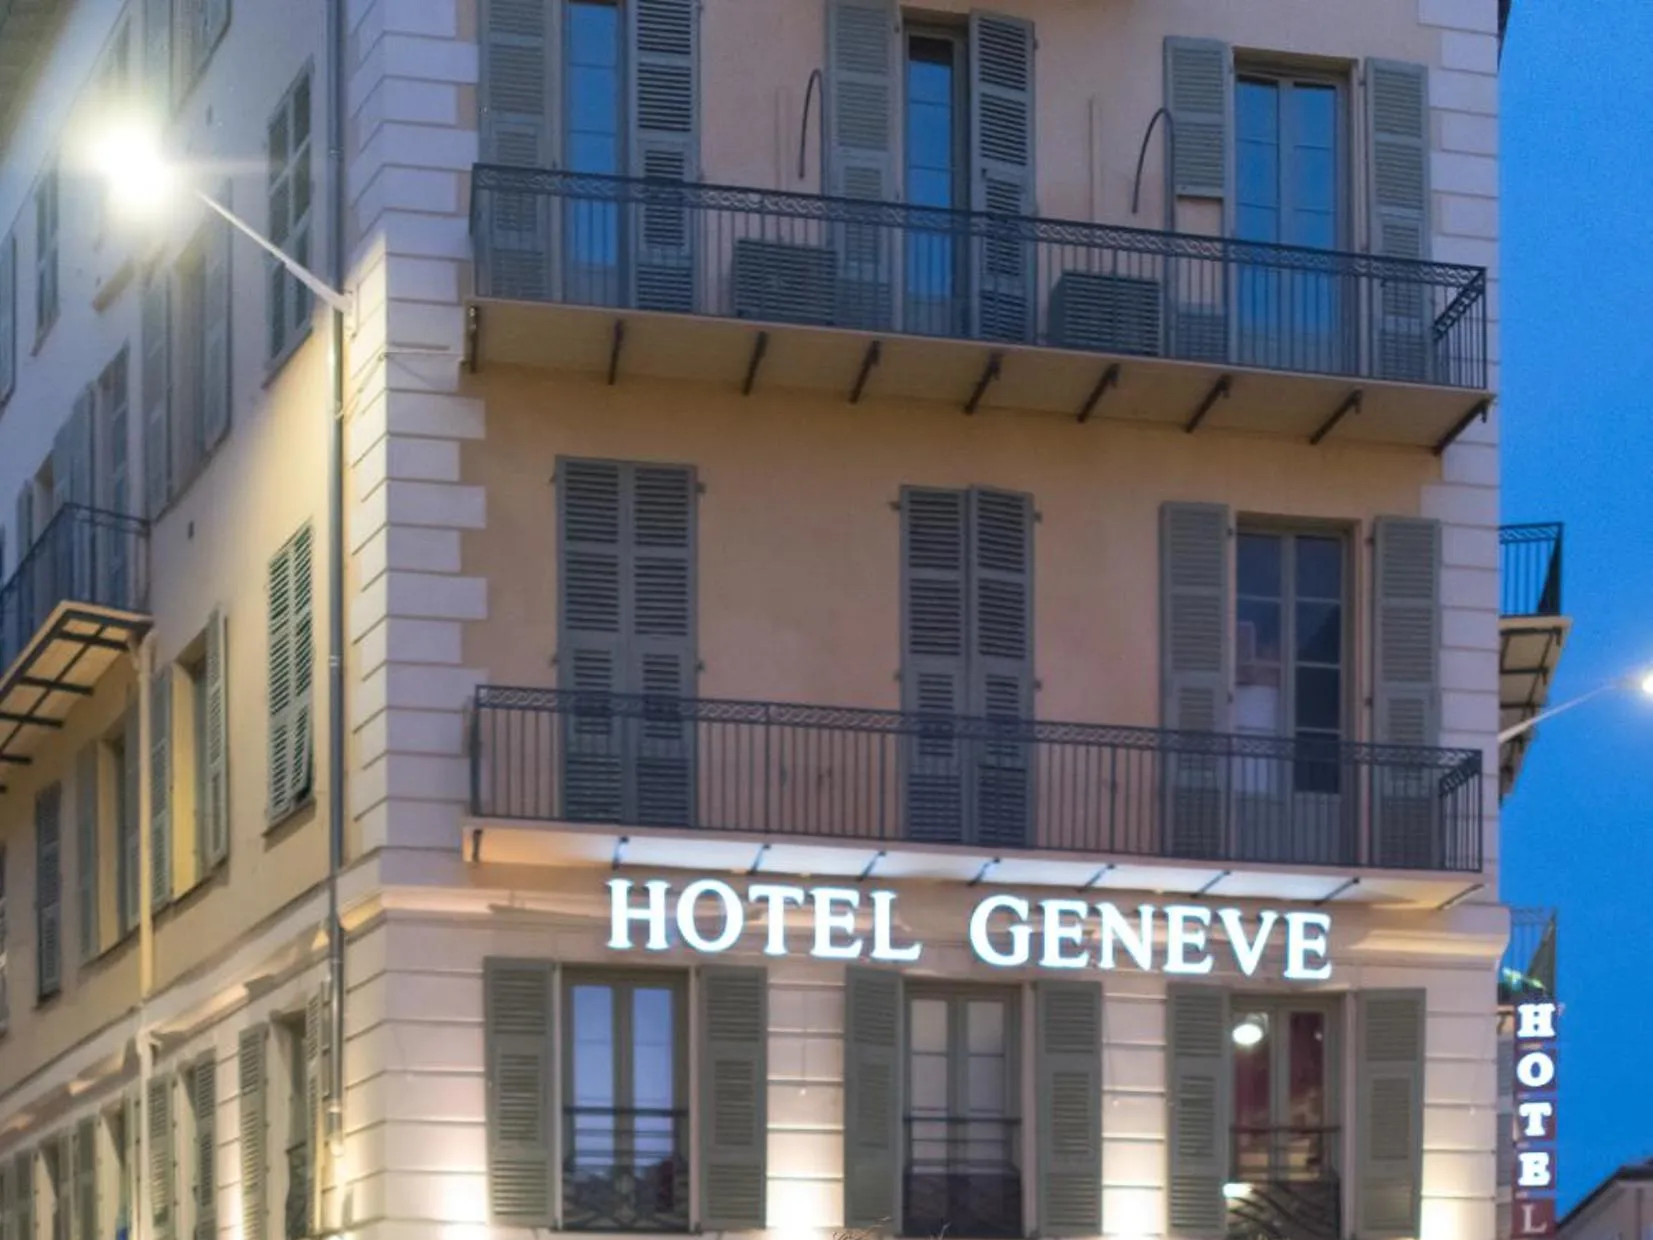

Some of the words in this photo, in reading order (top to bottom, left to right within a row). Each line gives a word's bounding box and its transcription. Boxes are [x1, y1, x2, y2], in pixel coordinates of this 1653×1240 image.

[606, 879, 921, 961] HOTEL
[969, 895, 1332, 979] GENEVE
[1516, 1003, 1556, 1233] HOTEL
